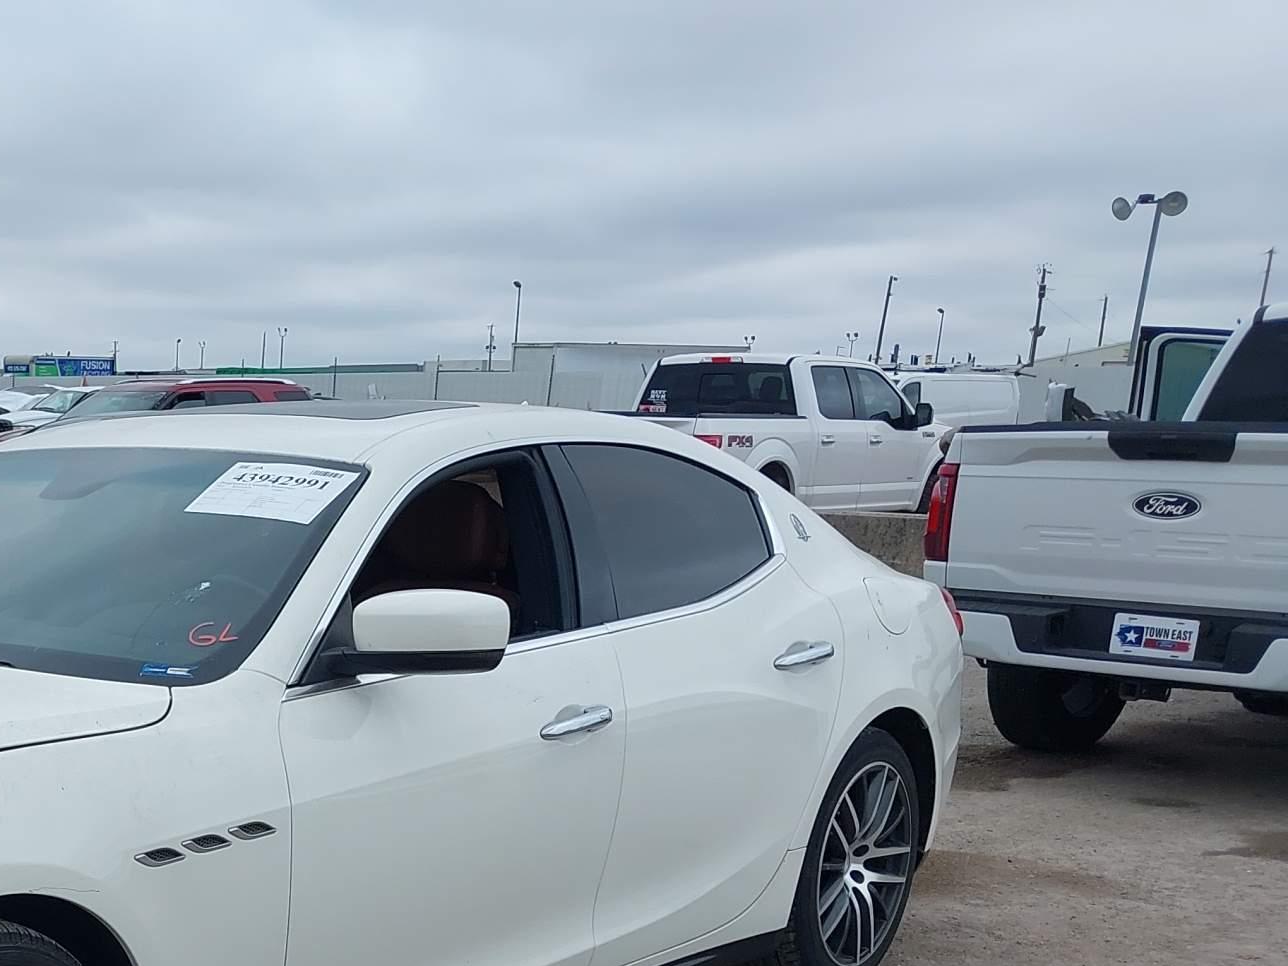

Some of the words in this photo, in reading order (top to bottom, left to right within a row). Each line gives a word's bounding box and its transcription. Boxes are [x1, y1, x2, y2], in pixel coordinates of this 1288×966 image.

[80, 360, 111, 370] FUSION
[232, 472, 330, 490] 43942991
[1142, 496, 1188, 515] Ford
[189, 622, 239, 647] GL
[1145, 626, 1170, 640] TOWN
[1170, 628, 1194, 642] EAST
